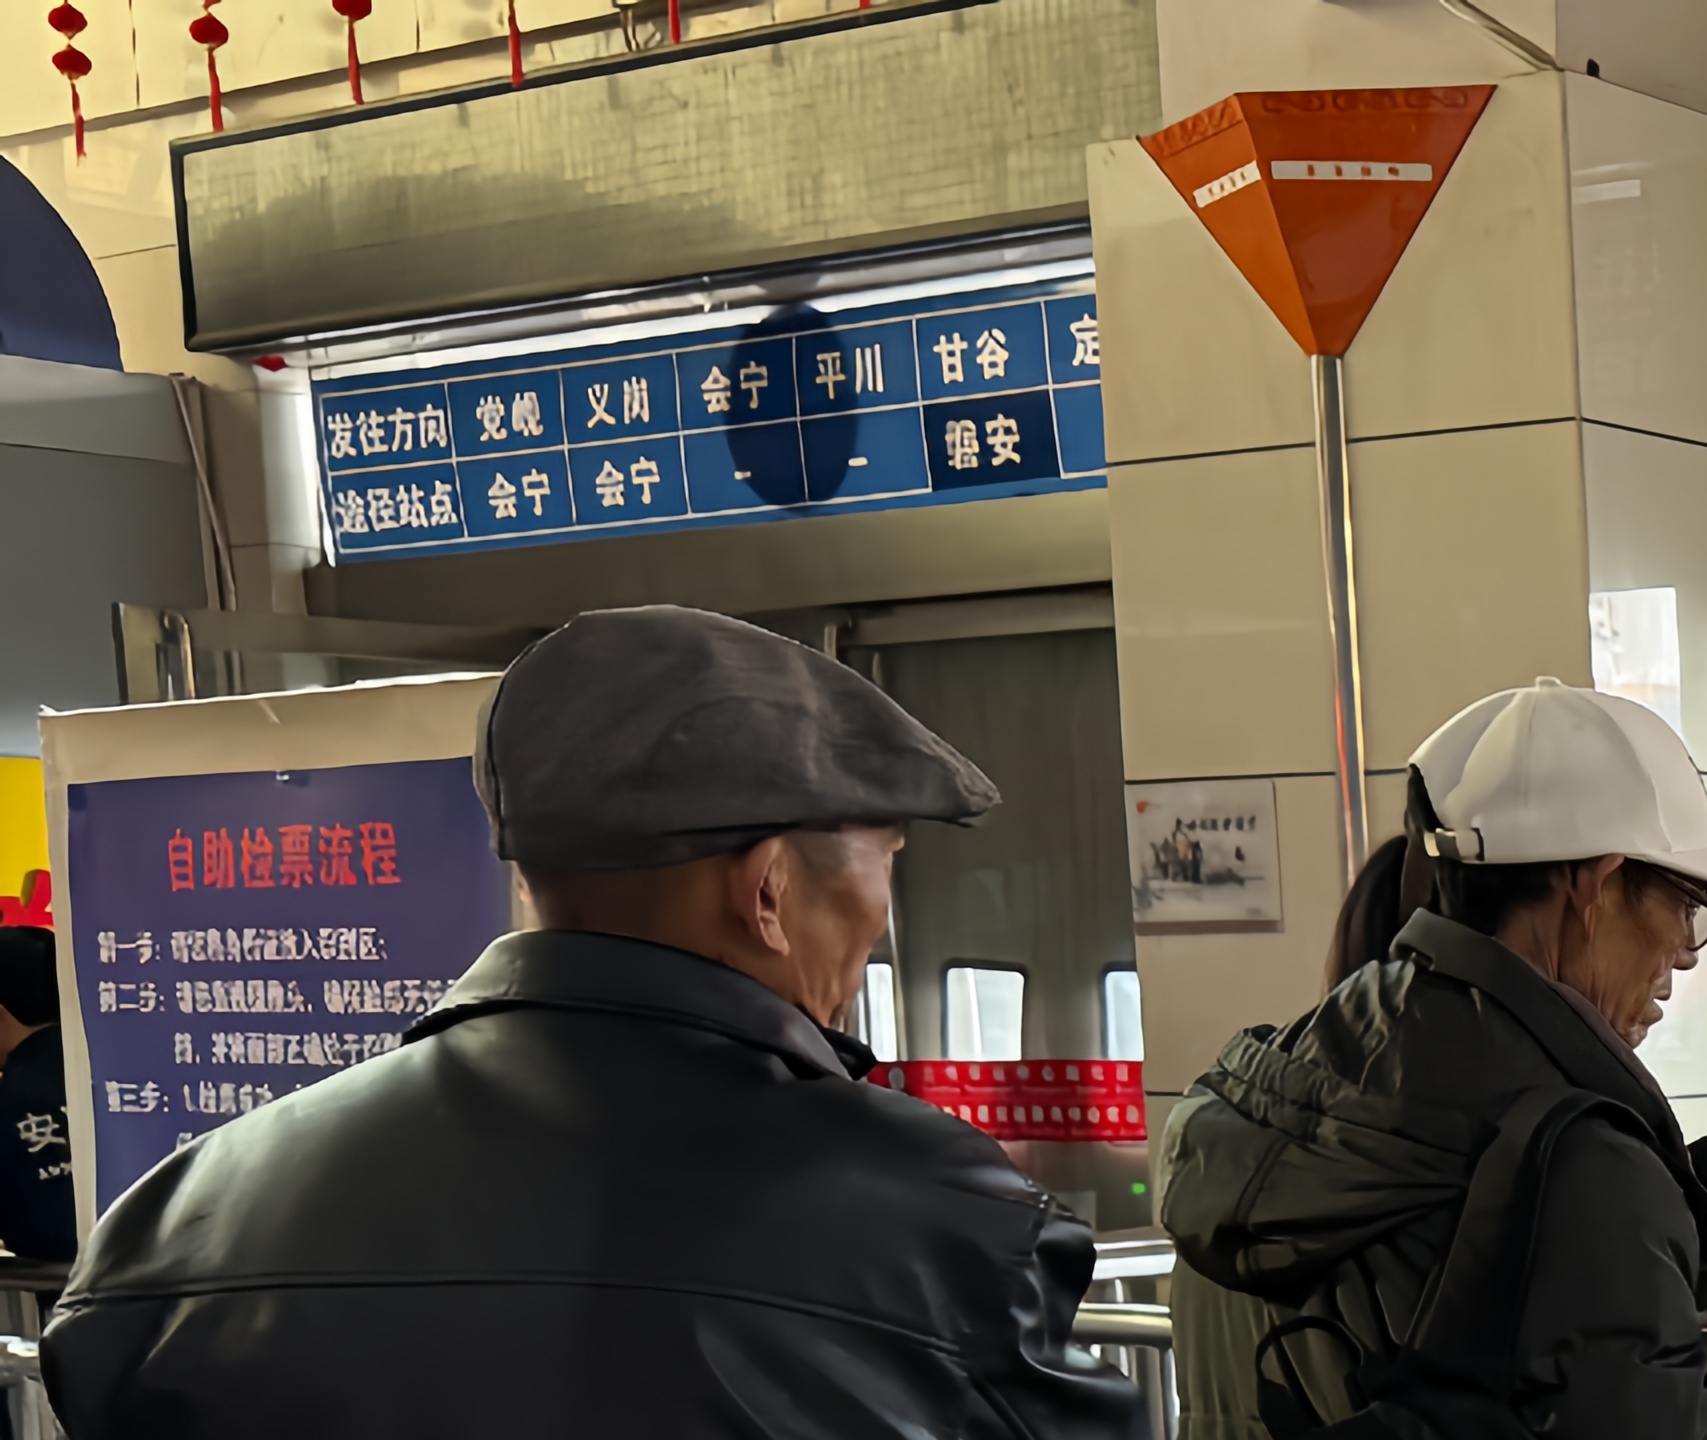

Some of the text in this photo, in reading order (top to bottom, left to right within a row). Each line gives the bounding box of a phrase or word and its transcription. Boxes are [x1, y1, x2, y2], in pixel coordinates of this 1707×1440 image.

[327, 403, 448, 458] 发往方向
[587, 376, 650, 429] 义岗
[700, 361, 769, 414] 会宁
[815, 344, 885, 398] 平川
[933, 328, 1009, 384] 甘谷
[335, 480, 459, 534] 途径站点
[488, 468, 551, 519] 会宁
[595, 456, 661, 508] 会宁
[167, 822, 401, 892] 自助检票流程
